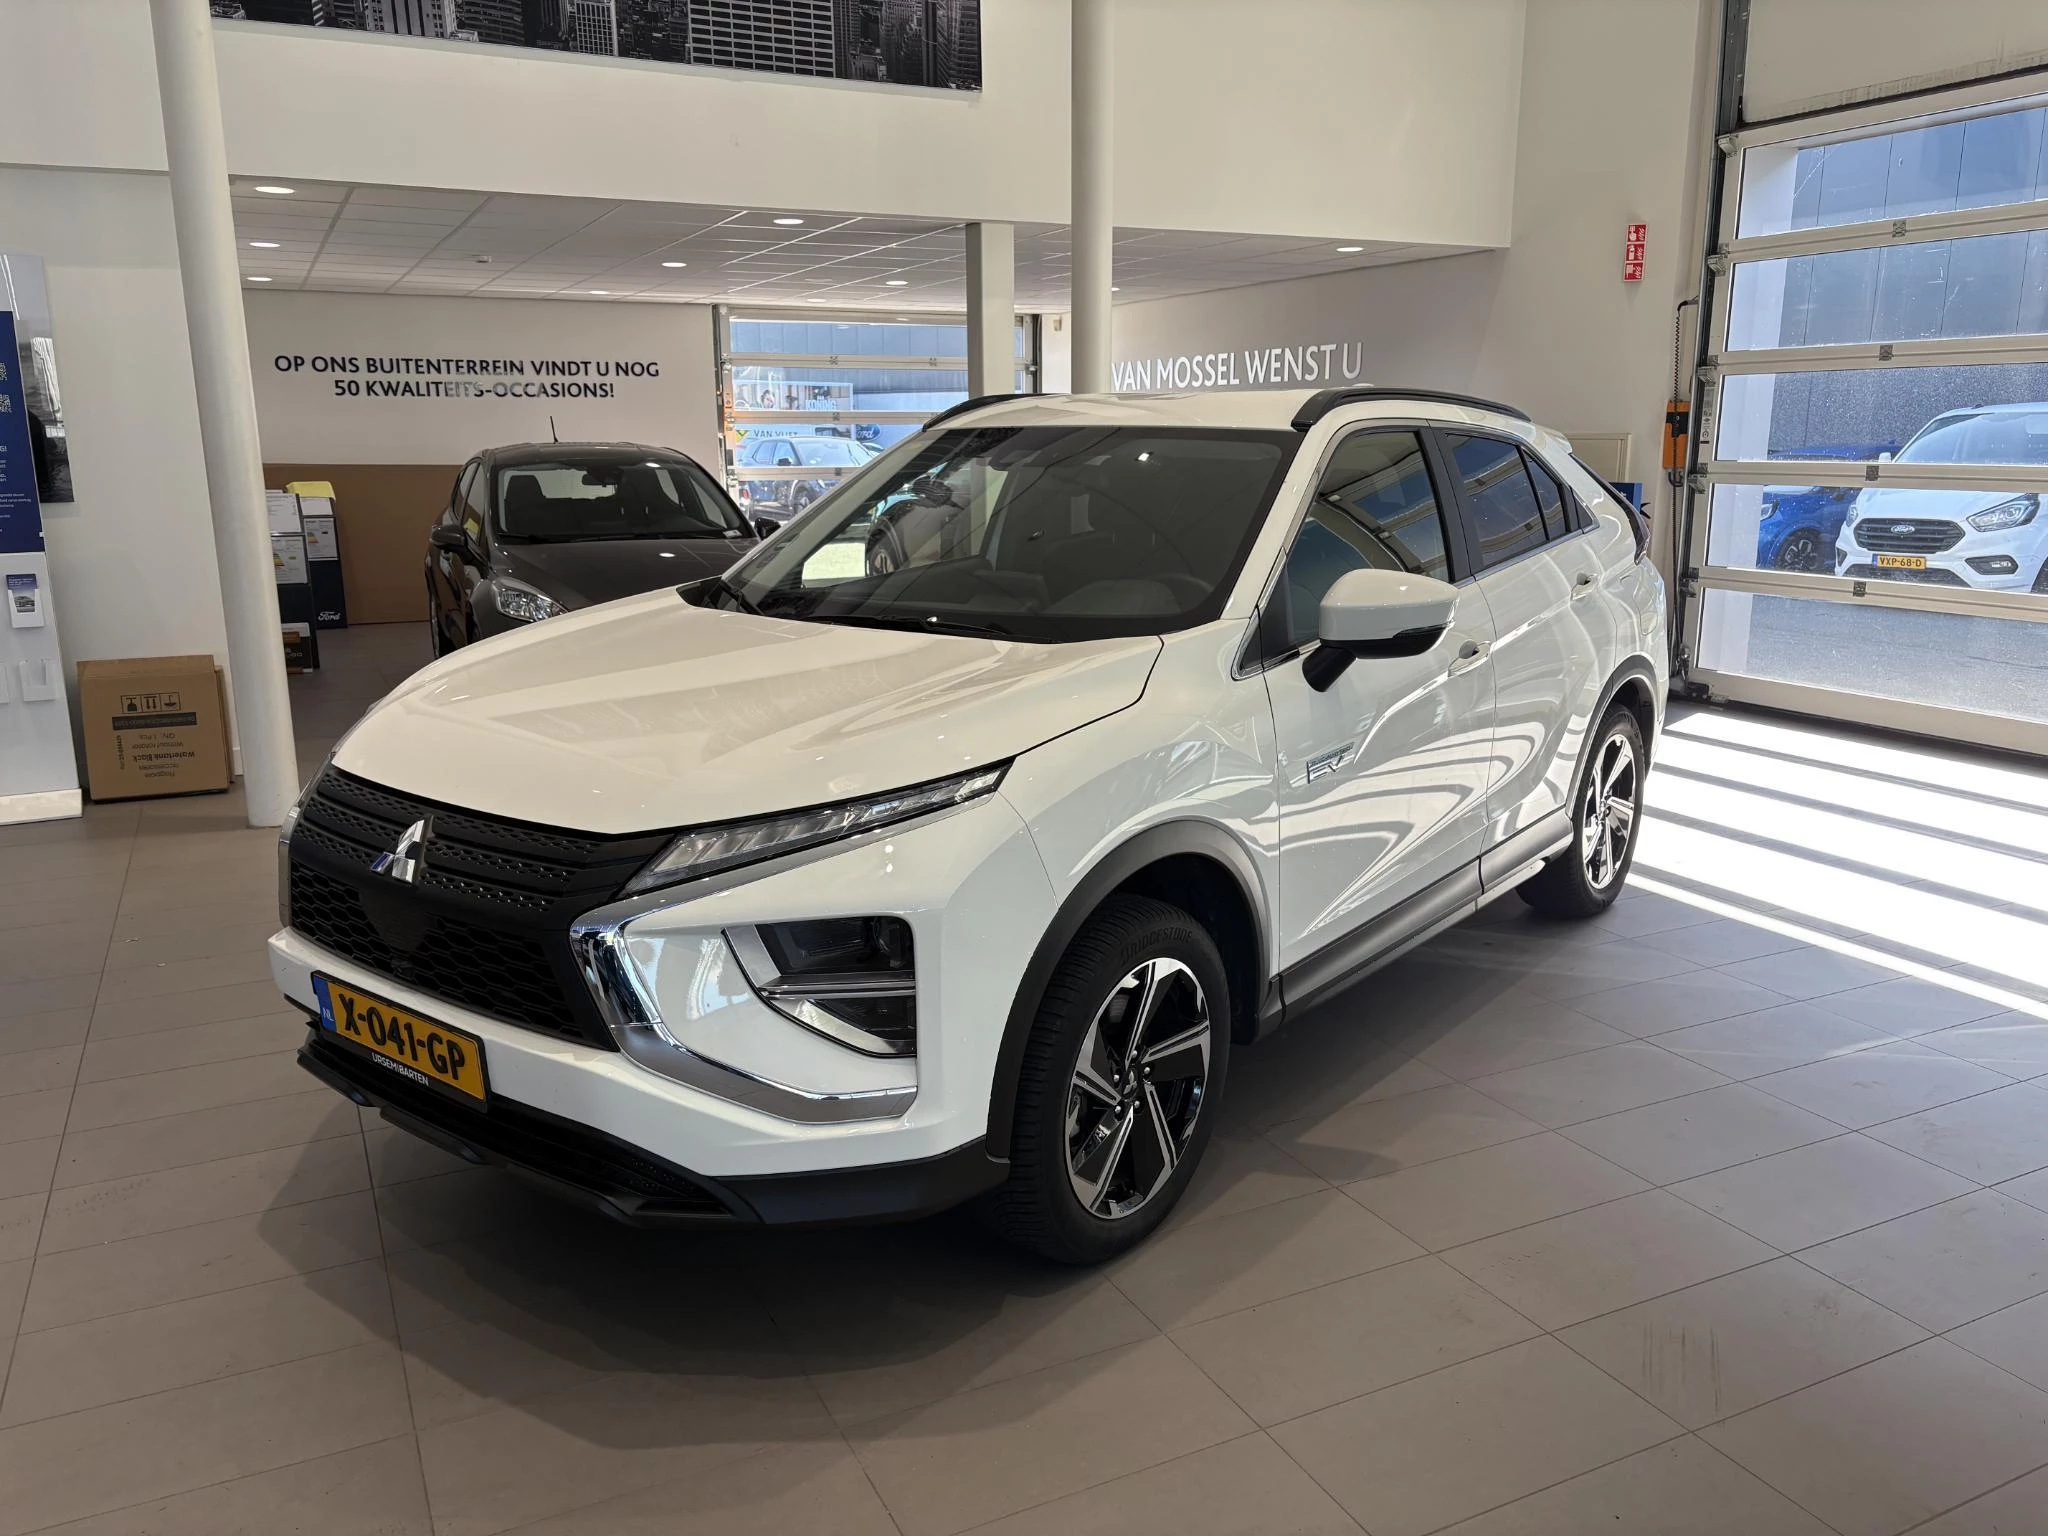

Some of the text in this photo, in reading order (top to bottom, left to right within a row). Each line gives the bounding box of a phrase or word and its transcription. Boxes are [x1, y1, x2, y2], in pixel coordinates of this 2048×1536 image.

[274, 355, 660, 377] OP ONS BUITENTERREIN VINDT U NOG
[1110, 341, 1363, 392] VAN MOSSEL WENST U
[334, 379, 615, 398] 50 KWALITEITS-OCCASIONS!
[753, 430, 773, 438] VAN
[1879, 556, 1922, 568] VXP-68-D
[338, 993, 466, 1081] X-041-GP
